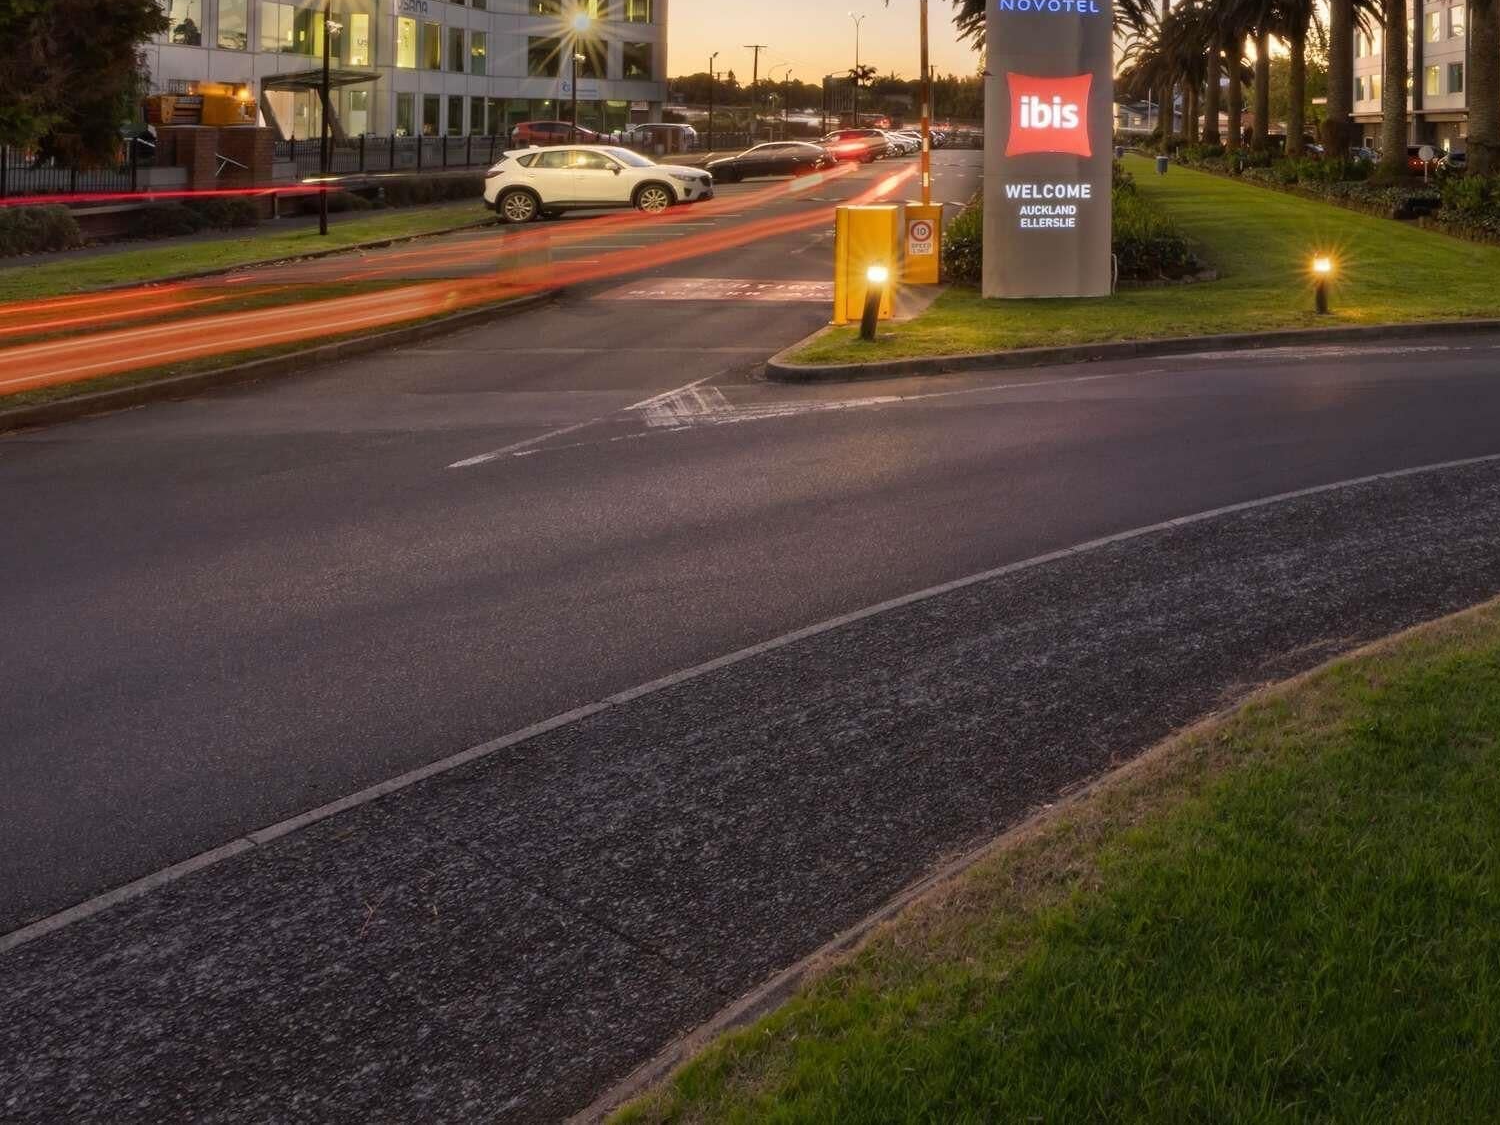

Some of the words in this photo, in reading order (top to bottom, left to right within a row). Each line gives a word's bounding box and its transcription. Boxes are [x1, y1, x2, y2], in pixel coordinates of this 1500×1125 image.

[1020, 96, 1079, 129] ibis
[1005, 184, 1092, 199] WELCOME
[1019, 205, 1077, 215] AUCKLAND
[1020, 218, 1075, 228] ELLERSLIE
[916, 226, 927, 236] 10
